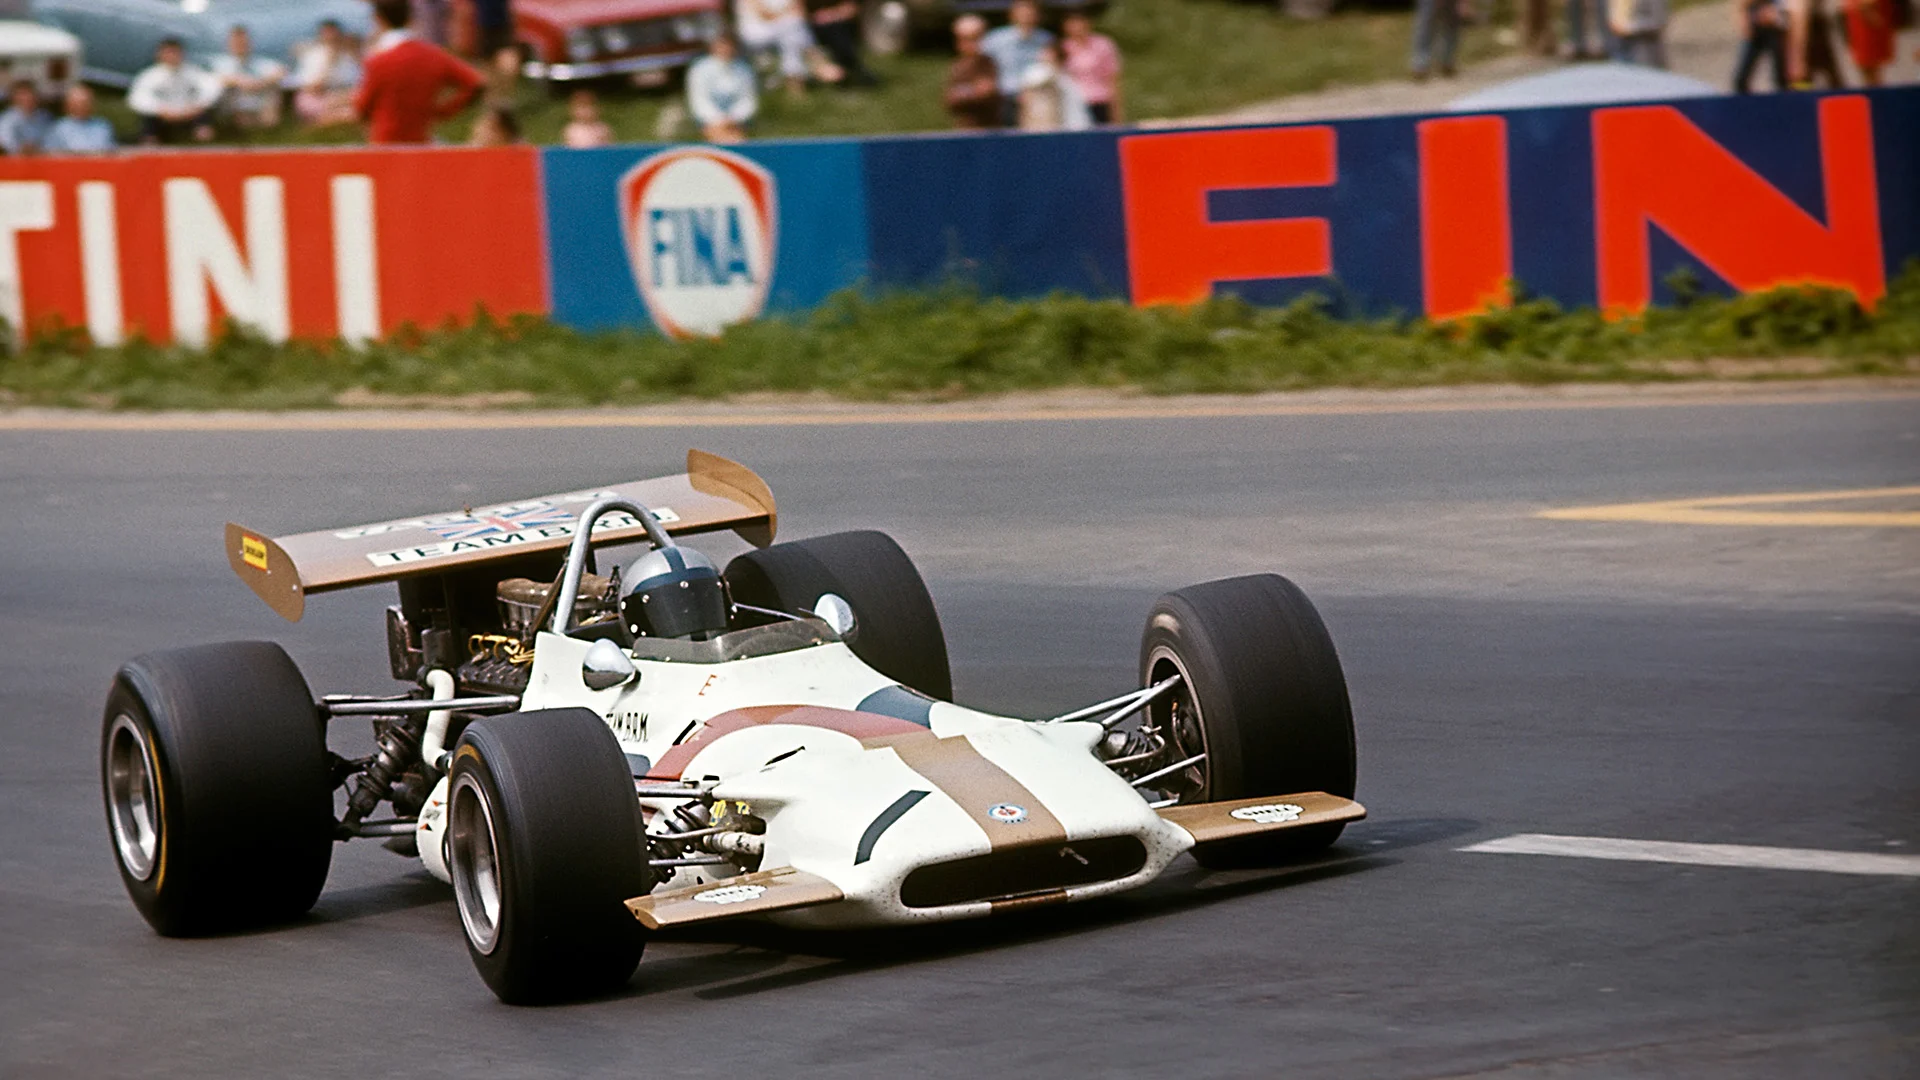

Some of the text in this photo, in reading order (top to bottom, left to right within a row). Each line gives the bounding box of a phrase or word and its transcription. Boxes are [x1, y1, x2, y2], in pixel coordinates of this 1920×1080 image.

[648, 206, 756, 288] FINA
[1118, 94, 1885, 324] FIN
[376, 532, 526, 562] TEAM
